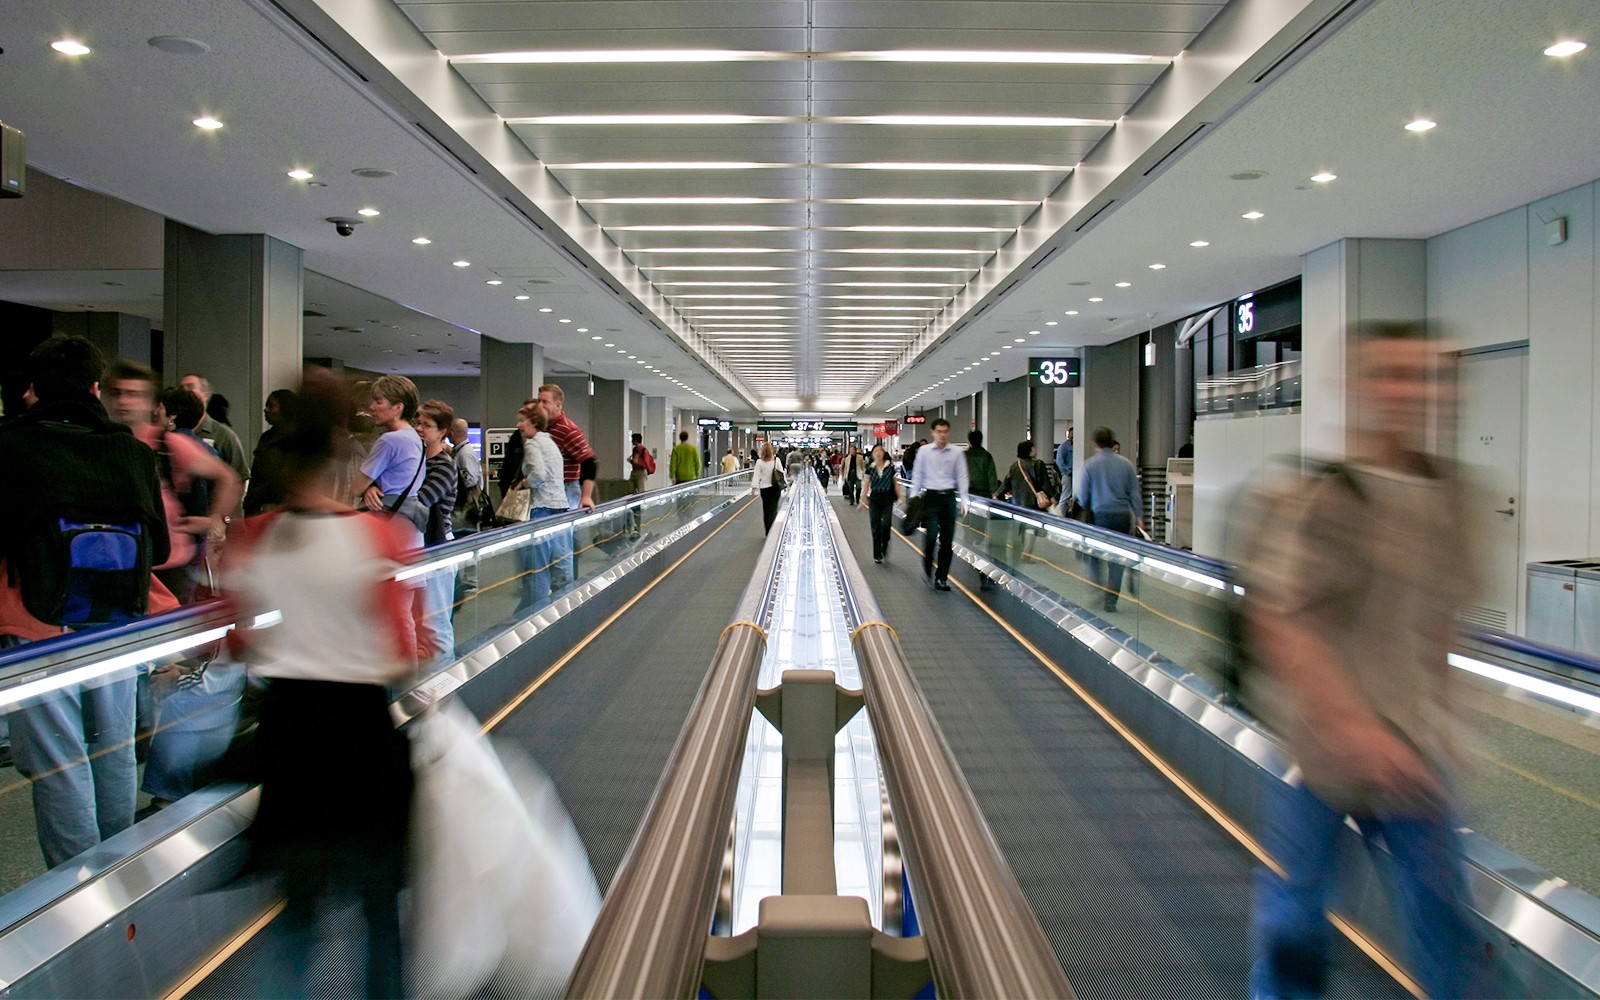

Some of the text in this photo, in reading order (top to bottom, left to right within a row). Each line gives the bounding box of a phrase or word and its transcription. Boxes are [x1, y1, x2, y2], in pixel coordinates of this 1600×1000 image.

[1238, 301, 1254, 333] 35
[1039, 360, 1068, 384] 35
[797, 421, 825, 431] 37-47
[493, 444, 500, 454] P
